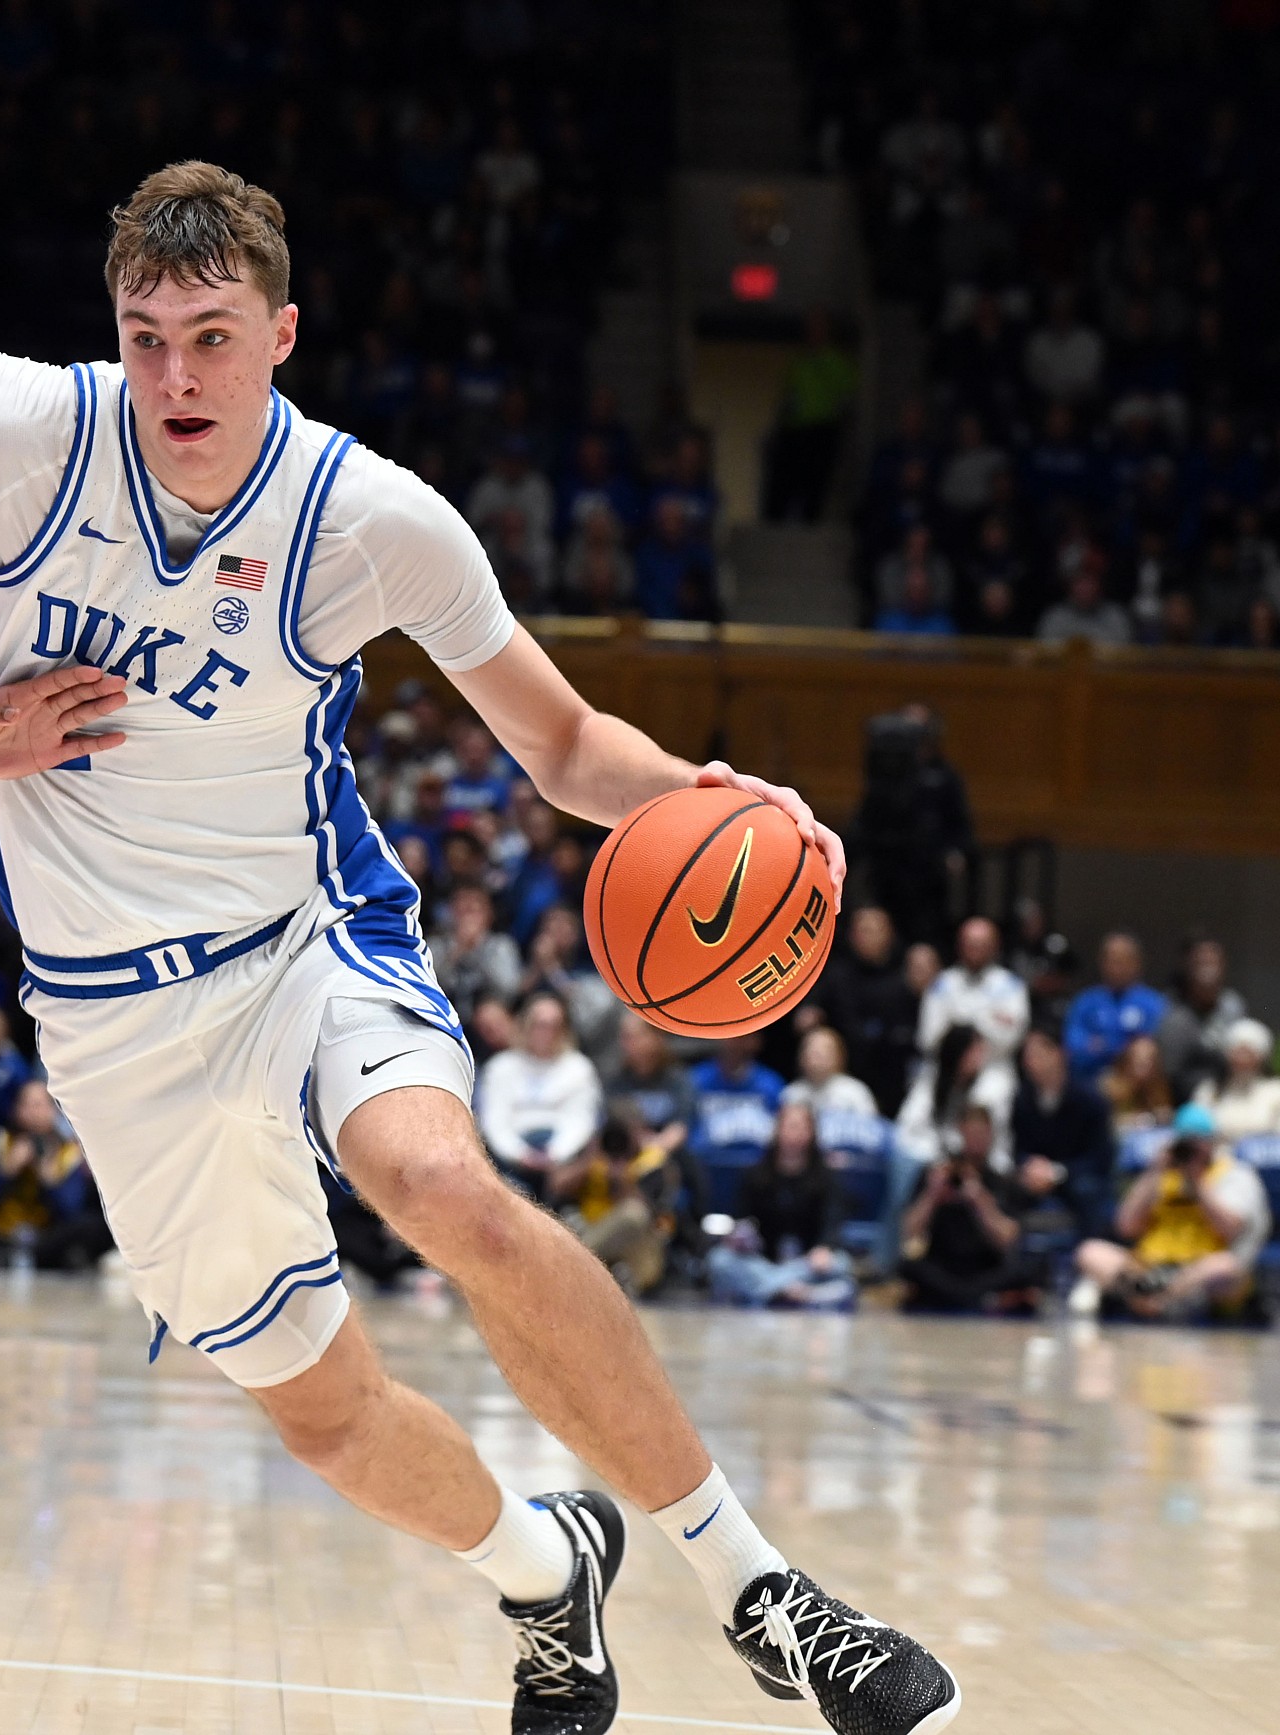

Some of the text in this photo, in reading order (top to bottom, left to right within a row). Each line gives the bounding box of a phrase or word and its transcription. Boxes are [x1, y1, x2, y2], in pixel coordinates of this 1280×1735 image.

[31, 591, 250, 720] DUKE
[144, 943, 195, 984] D
[736, 884, 828, 1003] ELITE
